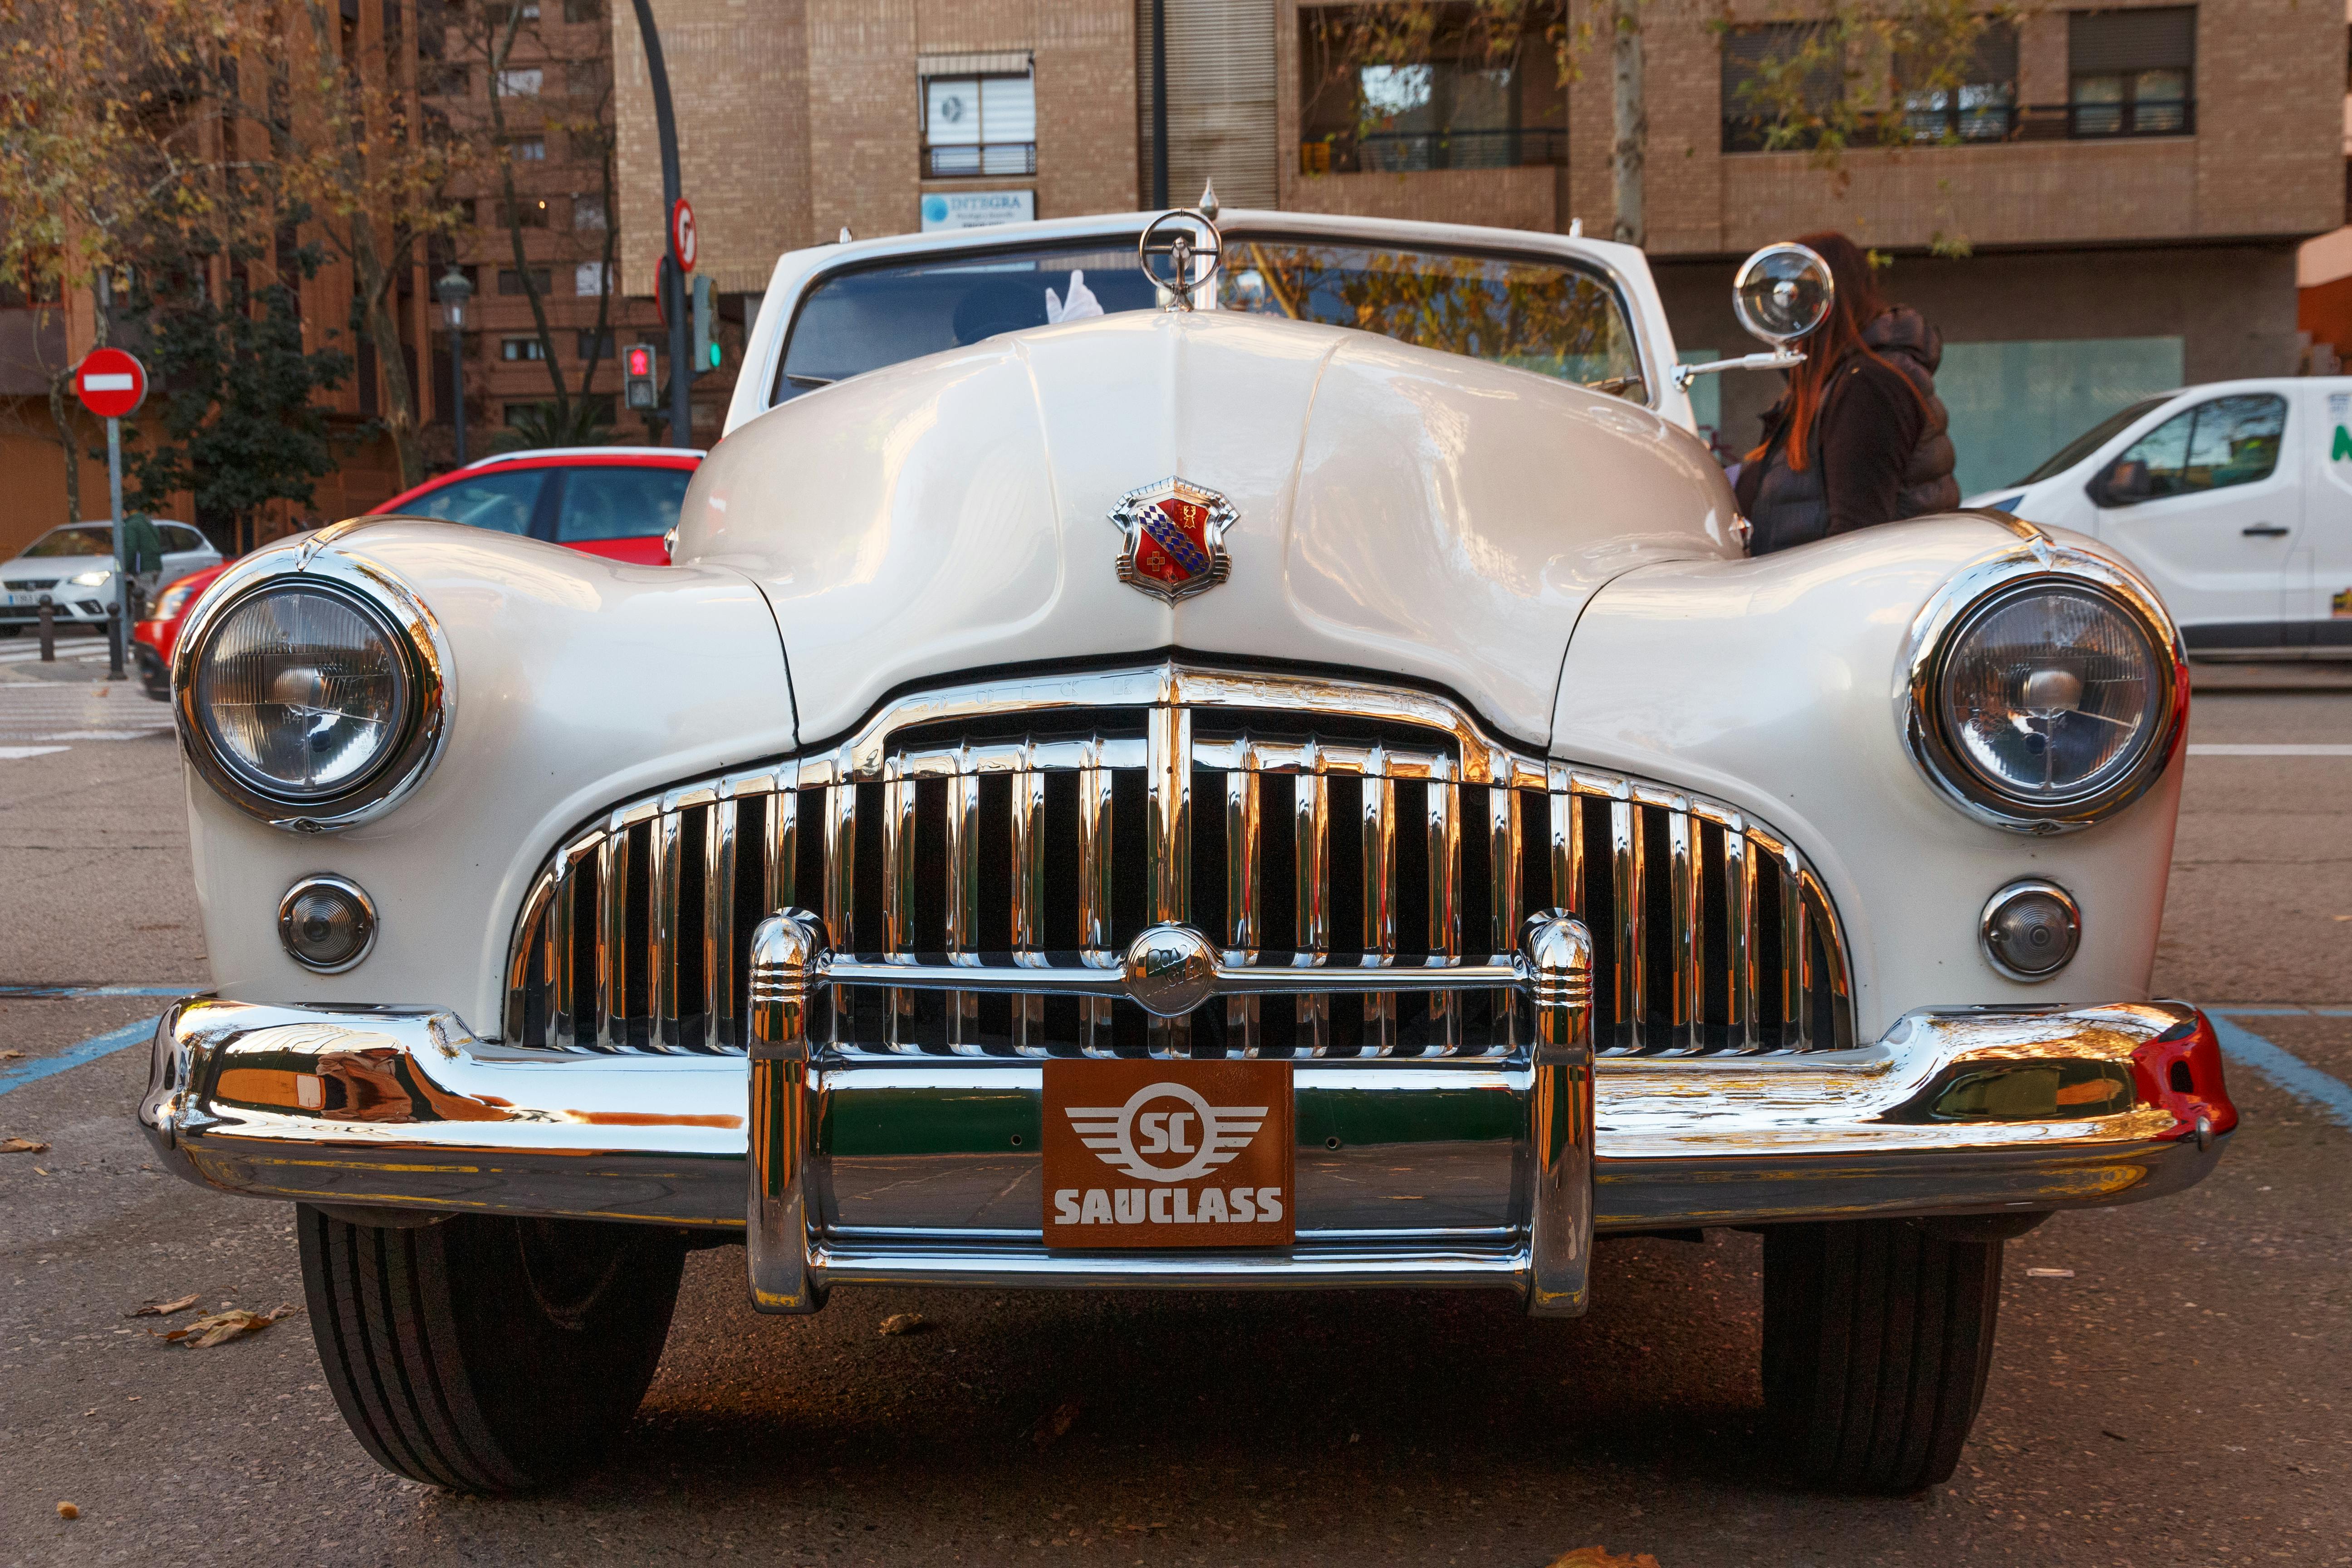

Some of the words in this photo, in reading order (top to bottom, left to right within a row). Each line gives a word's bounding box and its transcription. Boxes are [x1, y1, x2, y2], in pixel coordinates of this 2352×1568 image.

[951, 196, 1021, 210] INTEGRA
[282, 712, 301, 724] H4
[1147, 944, 1191, 975] ROAD
[1140, 1112, 1195, 1154] SC
[1054, 1187, 1283, 1225] SAUCLASS
